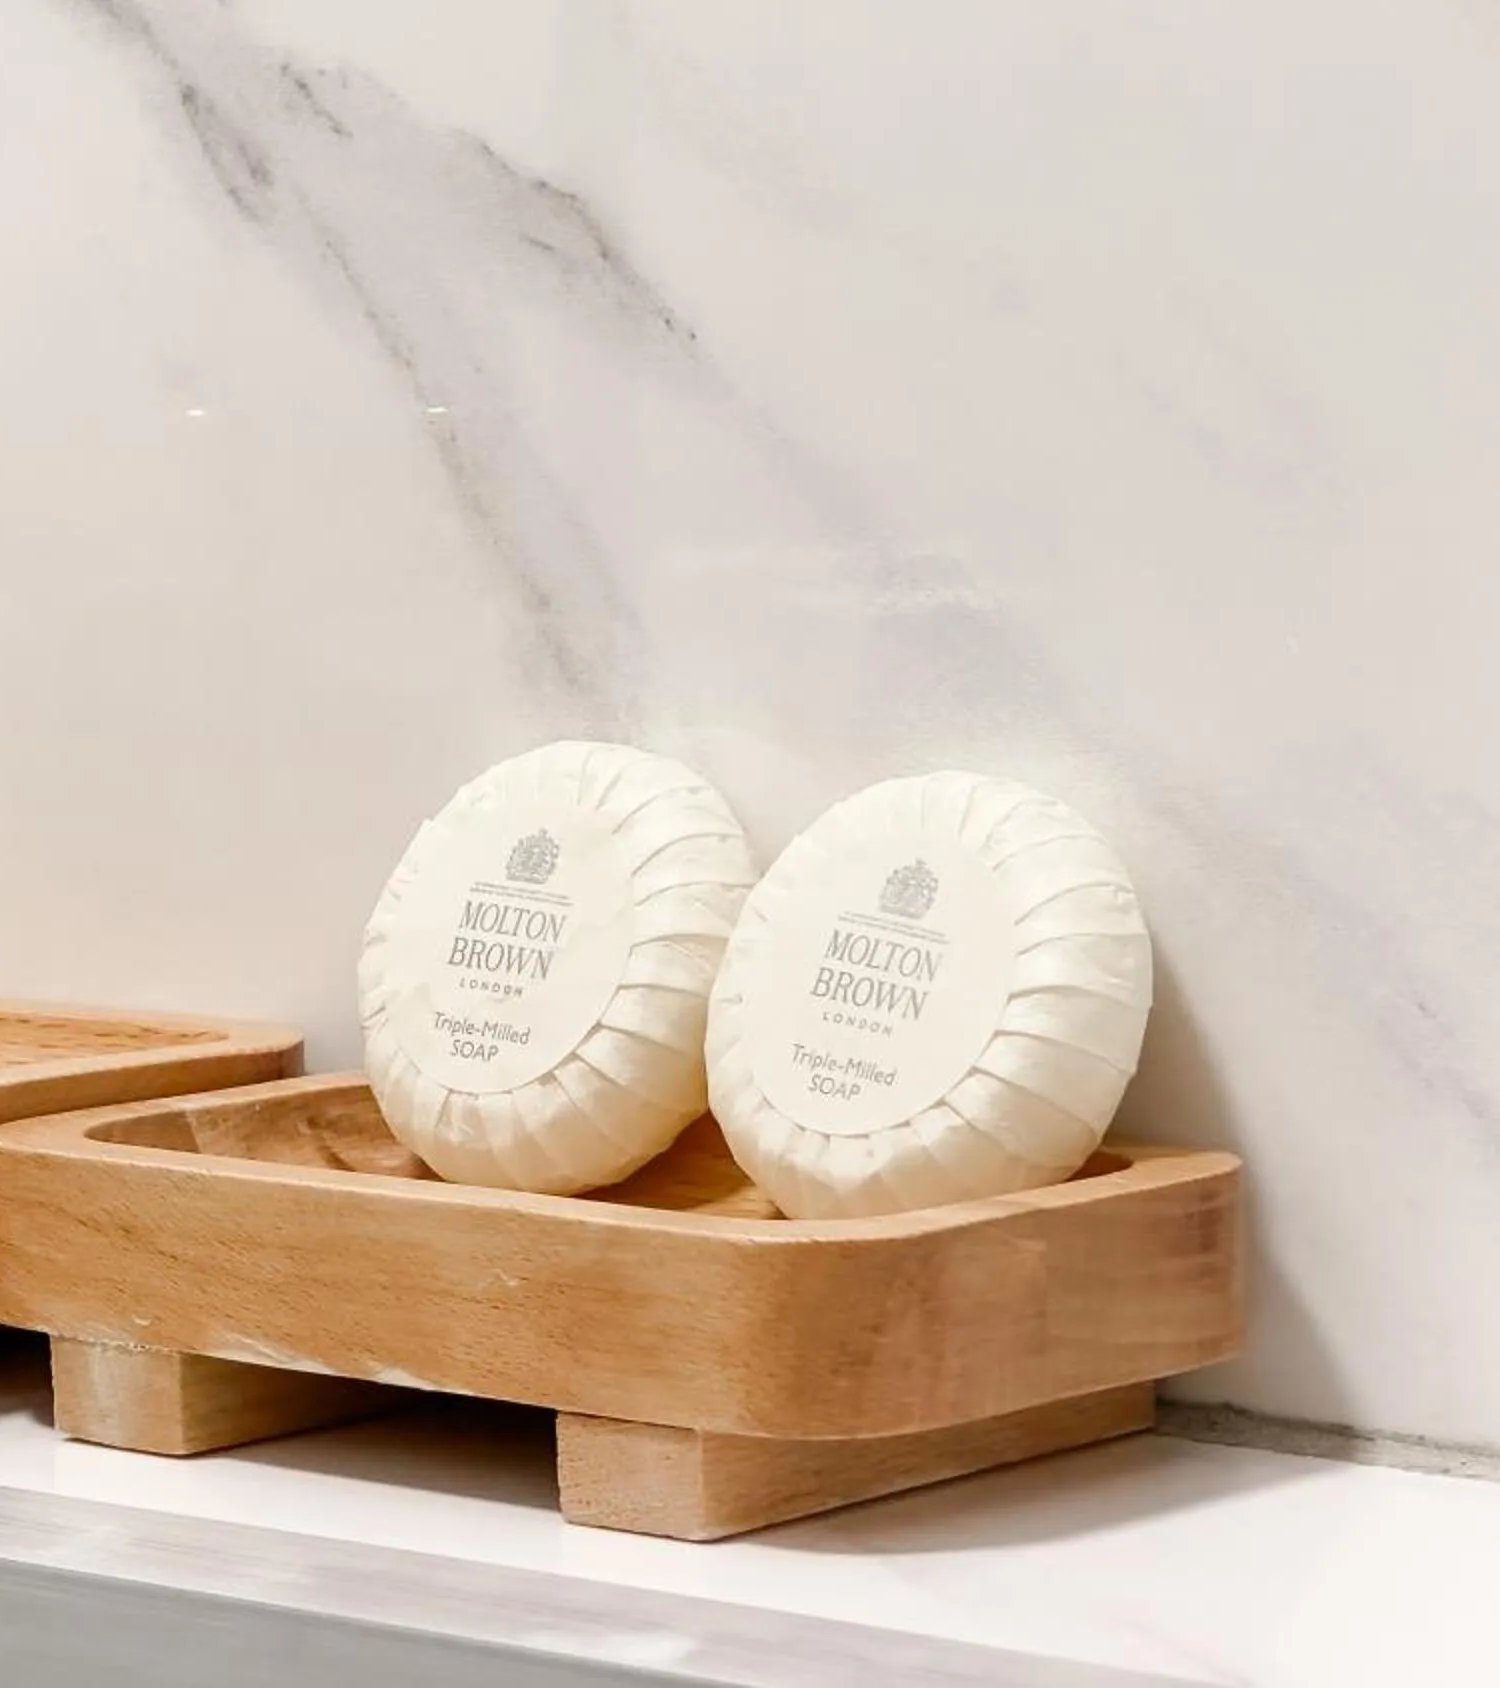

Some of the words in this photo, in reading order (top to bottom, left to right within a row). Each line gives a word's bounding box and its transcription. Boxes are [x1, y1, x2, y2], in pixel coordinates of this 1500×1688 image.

[458, 900, 567, 944] MOLTON
[447, 936, 555, 980] BROWN
[823, 928, 944, 983] MOLTON
[458, 977, 524, 998] LONDON
[809, 966, 930, 1021] BROWN
[434, 1010, 531, 1046] Triple-Milled
[822, 1010, 894, 1038] LONDON
[450, 1038, 500, 1062] SOAP
[791, 1043, 898, 1087] Triple-Milled
[808, 1073, 861, 1101] SOAP
